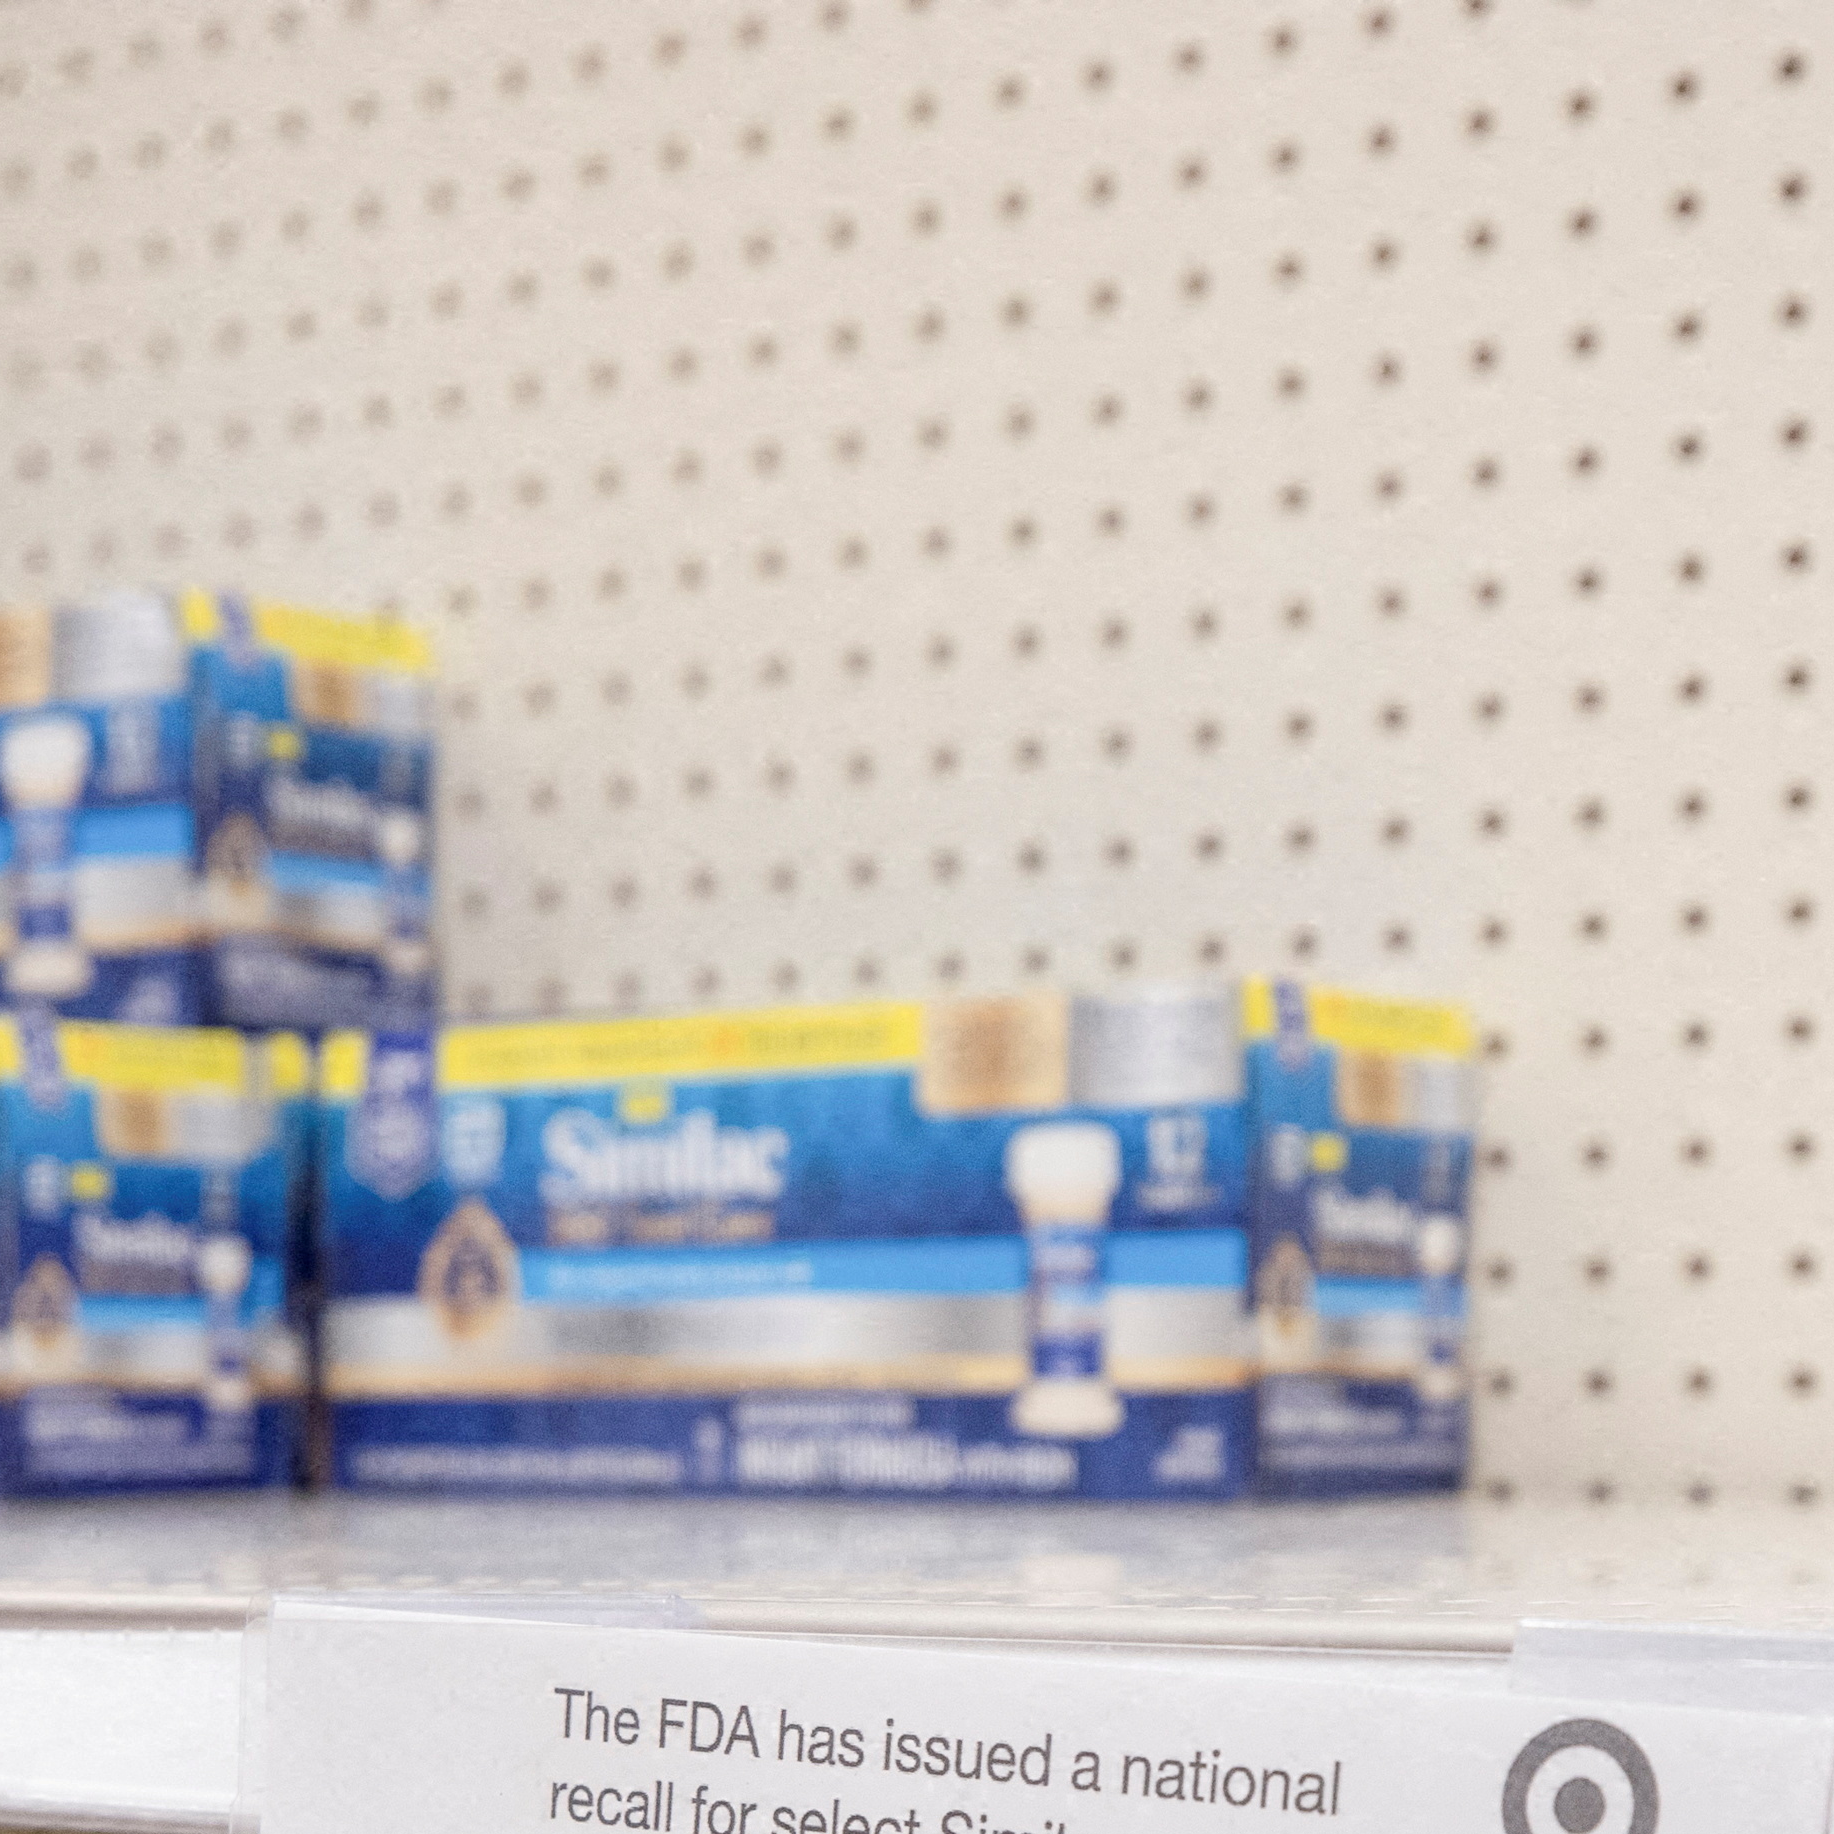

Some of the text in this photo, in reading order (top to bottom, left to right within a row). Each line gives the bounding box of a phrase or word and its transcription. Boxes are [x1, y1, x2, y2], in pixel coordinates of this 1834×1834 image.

[553, 1686, 1342, 1816] The FDA has issued a national
[550, 1779, 674, 1833] recall
